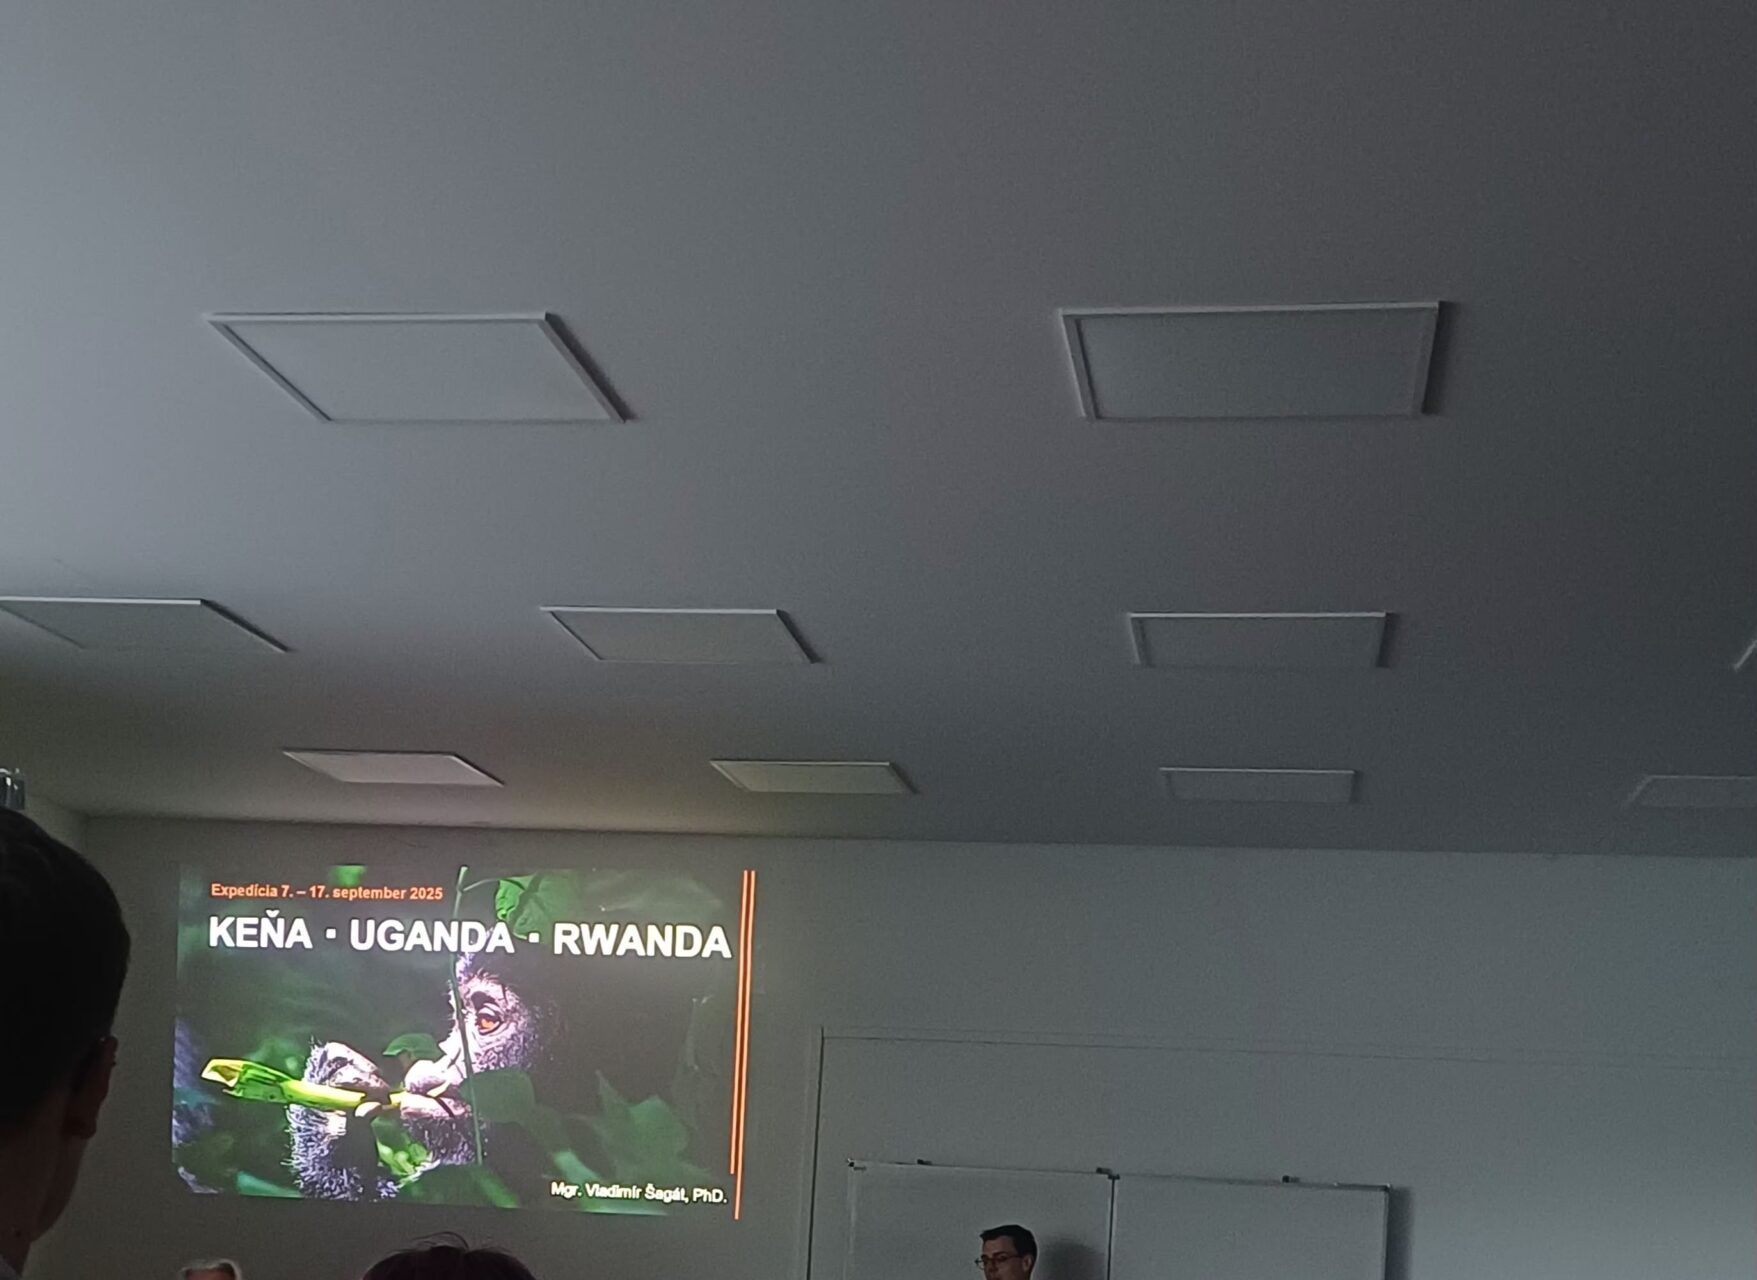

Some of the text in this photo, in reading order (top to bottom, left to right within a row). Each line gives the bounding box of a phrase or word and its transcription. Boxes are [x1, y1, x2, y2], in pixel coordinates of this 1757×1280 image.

[211, 883, 278, 899] Expedícia
[281, 884, 294, 898] 7.
[309, 885, 329, 898] 17.
[333, 885, 407, 901] september
[409, 886, 443, 900] 2025
[208, 909, 732, 958] KEŇA UGANDA RWANDA
[551, 1181, 582, 1199] Mgr.
[692, 1187, 728, 1203] PhD.
